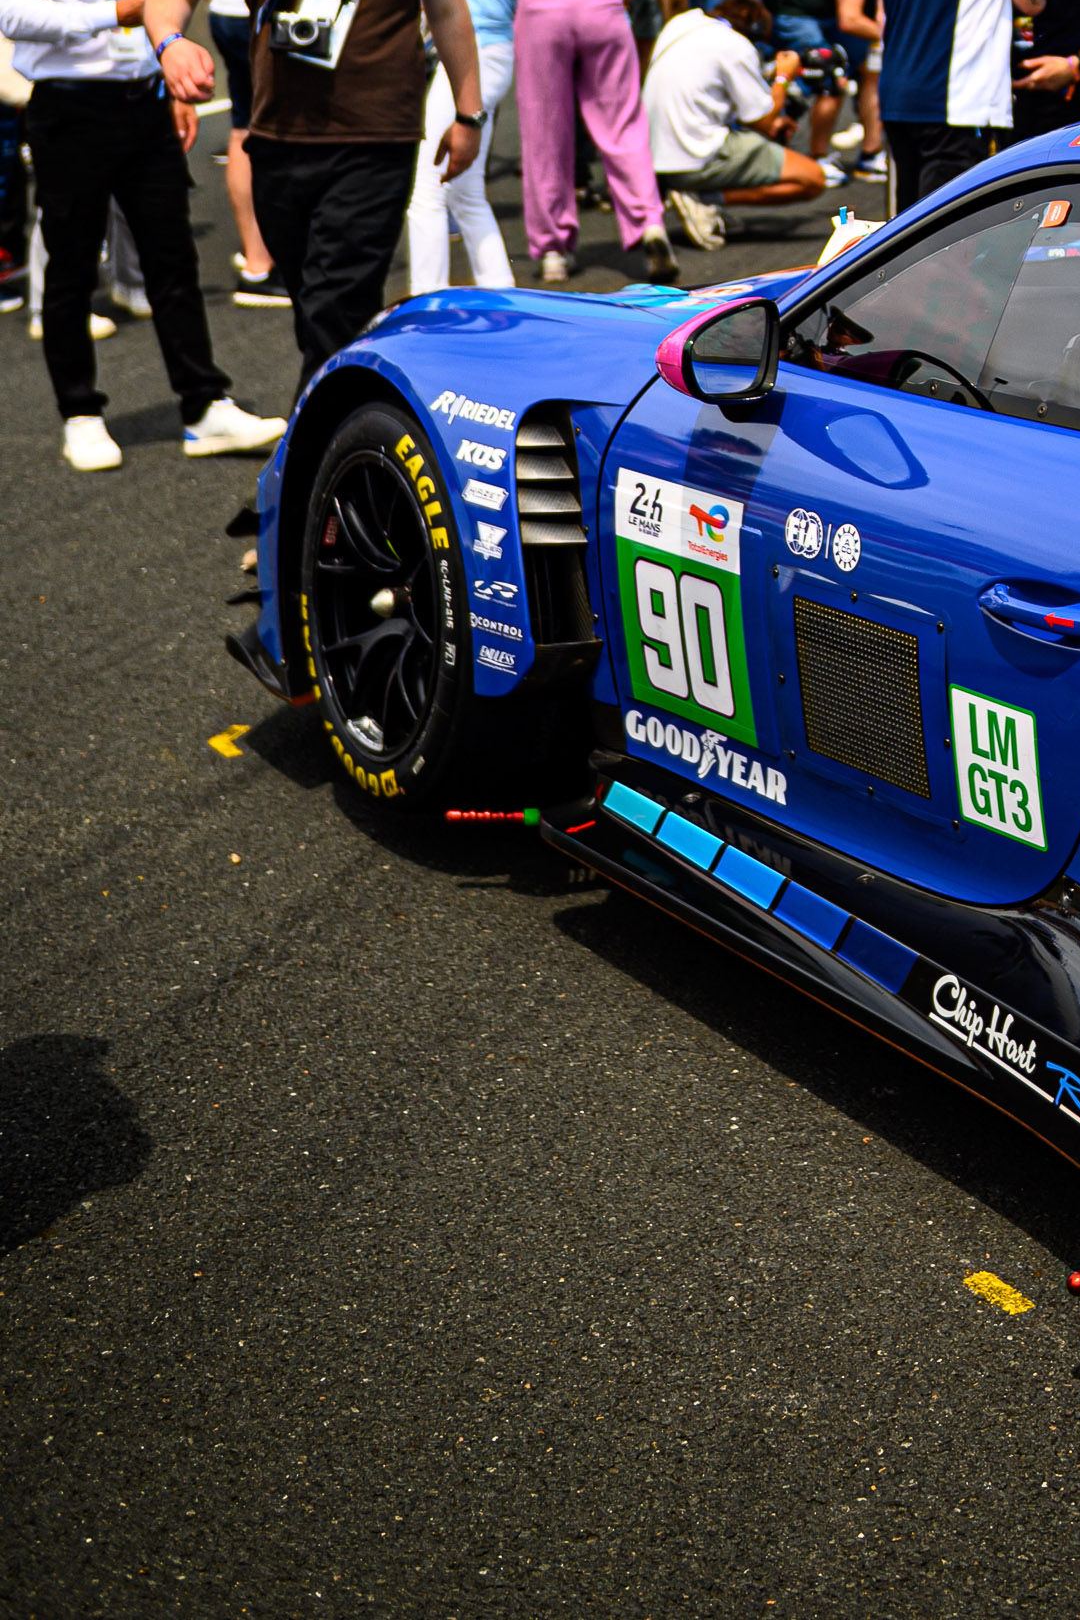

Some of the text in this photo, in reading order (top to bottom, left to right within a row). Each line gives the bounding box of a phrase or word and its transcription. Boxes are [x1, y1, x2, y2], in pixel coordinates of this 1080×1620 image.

[396, 434, 449, 550] EAGLE
[628, 515, 637, 526] LE
[640, 519, 661, 533] MANS
[687, 540, 728, 562] TotalEnergies
[476, 616, 523, 638] CONTROL
[635, 558, 735, 717] 90
[625, 709, 787, 806] GOODYEAR
[968, 702, 1020, 771] LM
[967, 761, 1033, 833] GT3
[932, 974, 984, 1048] Chip
[986, 1004, 1037, 1074] Hart
